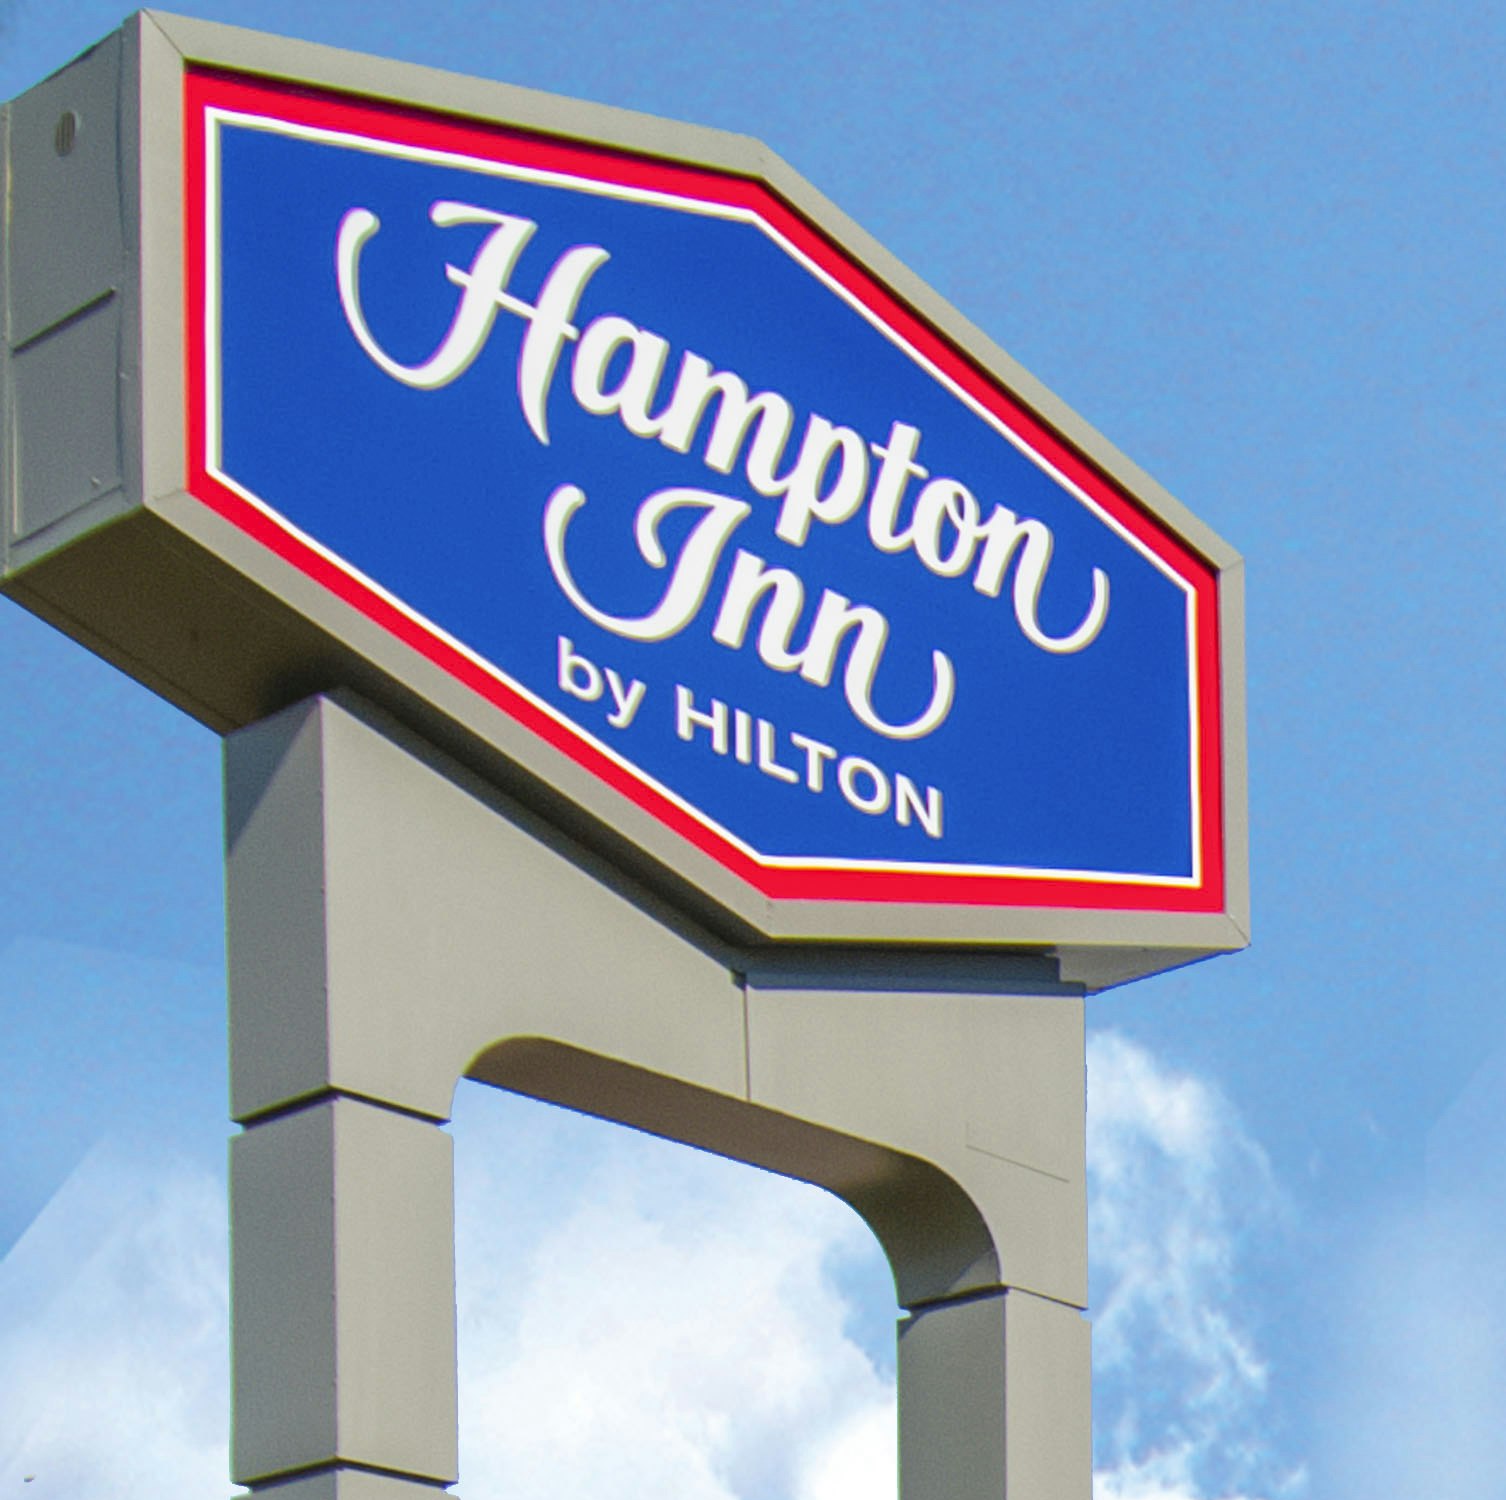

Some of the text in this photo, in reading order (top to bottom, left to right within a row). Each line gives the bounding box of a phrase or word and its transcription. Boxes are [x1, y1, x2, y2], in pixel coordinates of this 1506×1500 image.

[337, 201, 1110, 652] Hampton
[543, 484, 954, 740] Inn
[558, 635, 944, 838] by HILTON
